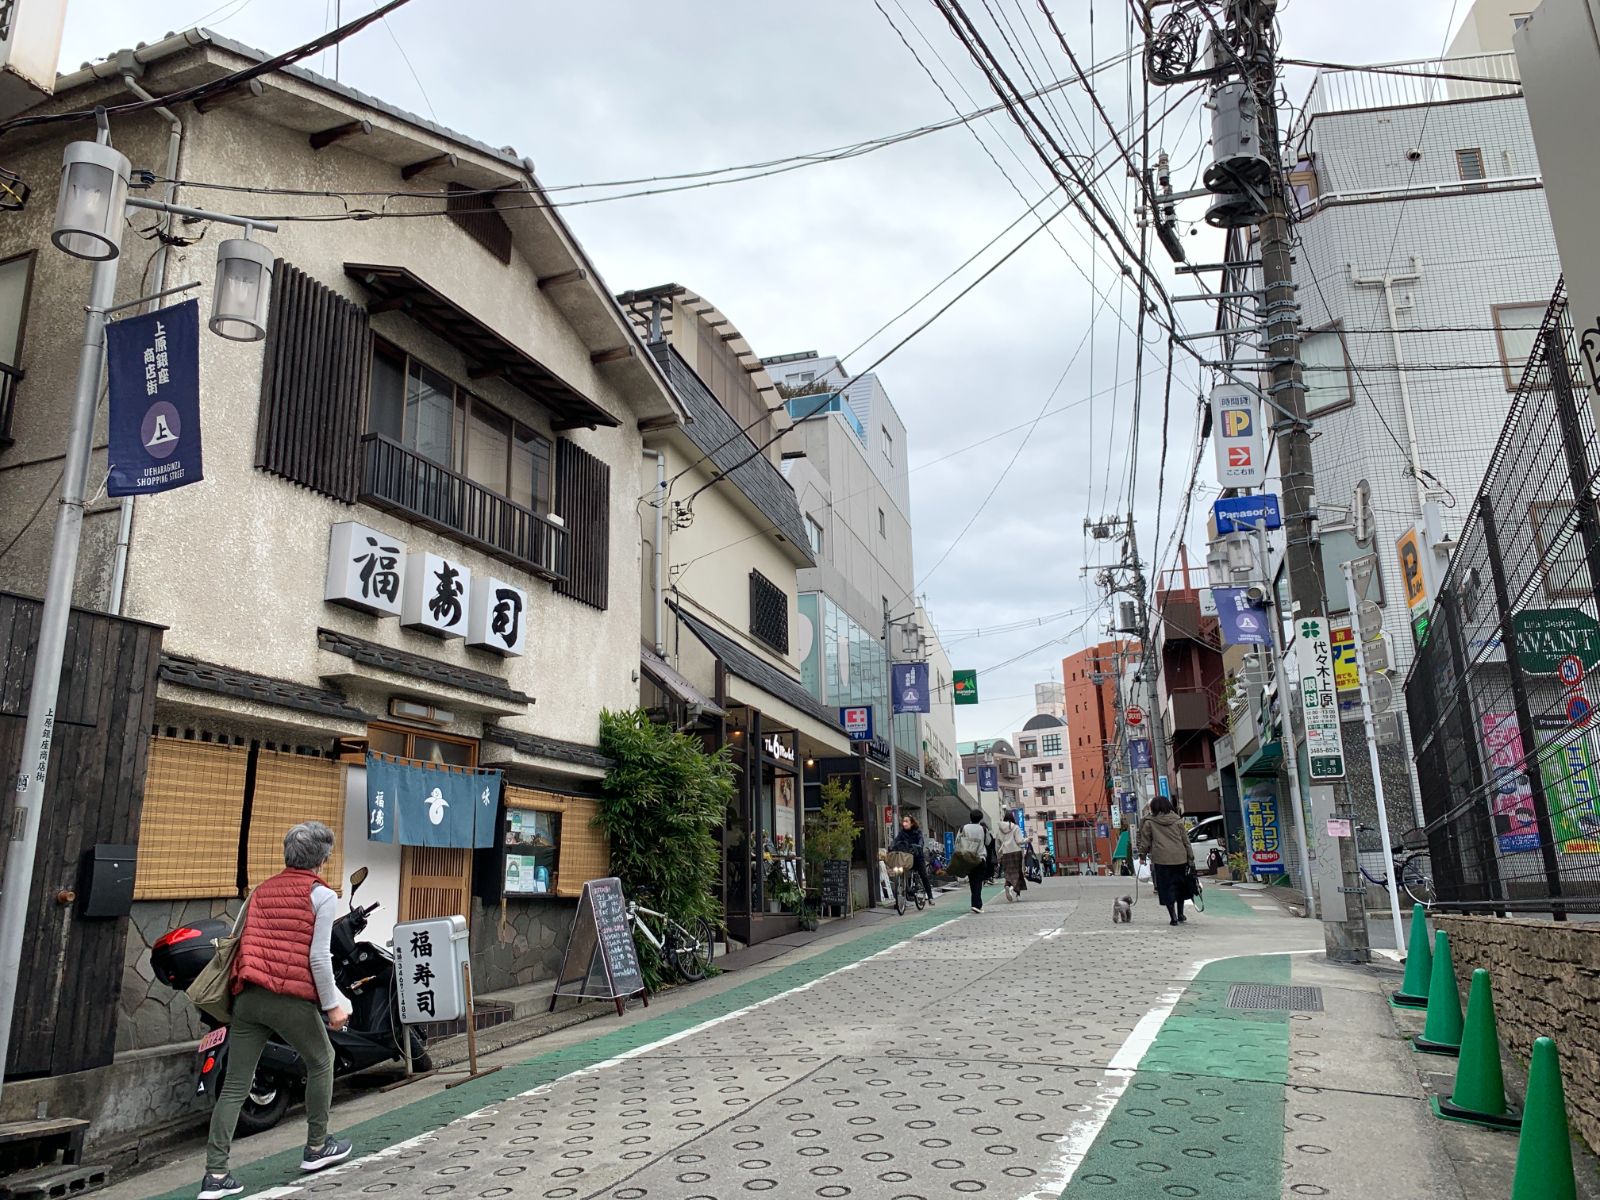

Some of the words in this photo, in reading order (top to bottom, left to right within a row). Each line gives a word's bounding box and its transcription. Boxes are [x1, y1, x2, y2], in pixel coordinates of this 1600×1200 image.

[144, 348, 158, 396] 商店街
[154, 321, 170, 385] 上原銀座
[1229, 410, 1250, 437] P
[136, 473, 168, 487] SHOPPING
[169, 469, 185, 482] STREET
[144, 461, 181, 476] UEHARAGINZA
[1219, 506, 1276, 519] Panasonic
[353, 536, 523, 649] 福寿司
[1516, 629, 1595, 653] AVANT
[1313, 641, 1333, 708] 代々木上原
[36, 707, 54, 782] 上原銀座商店街
[1262, 802, 1279, 852] エアコン
[410, 930, 436, 1018] 福寿司
